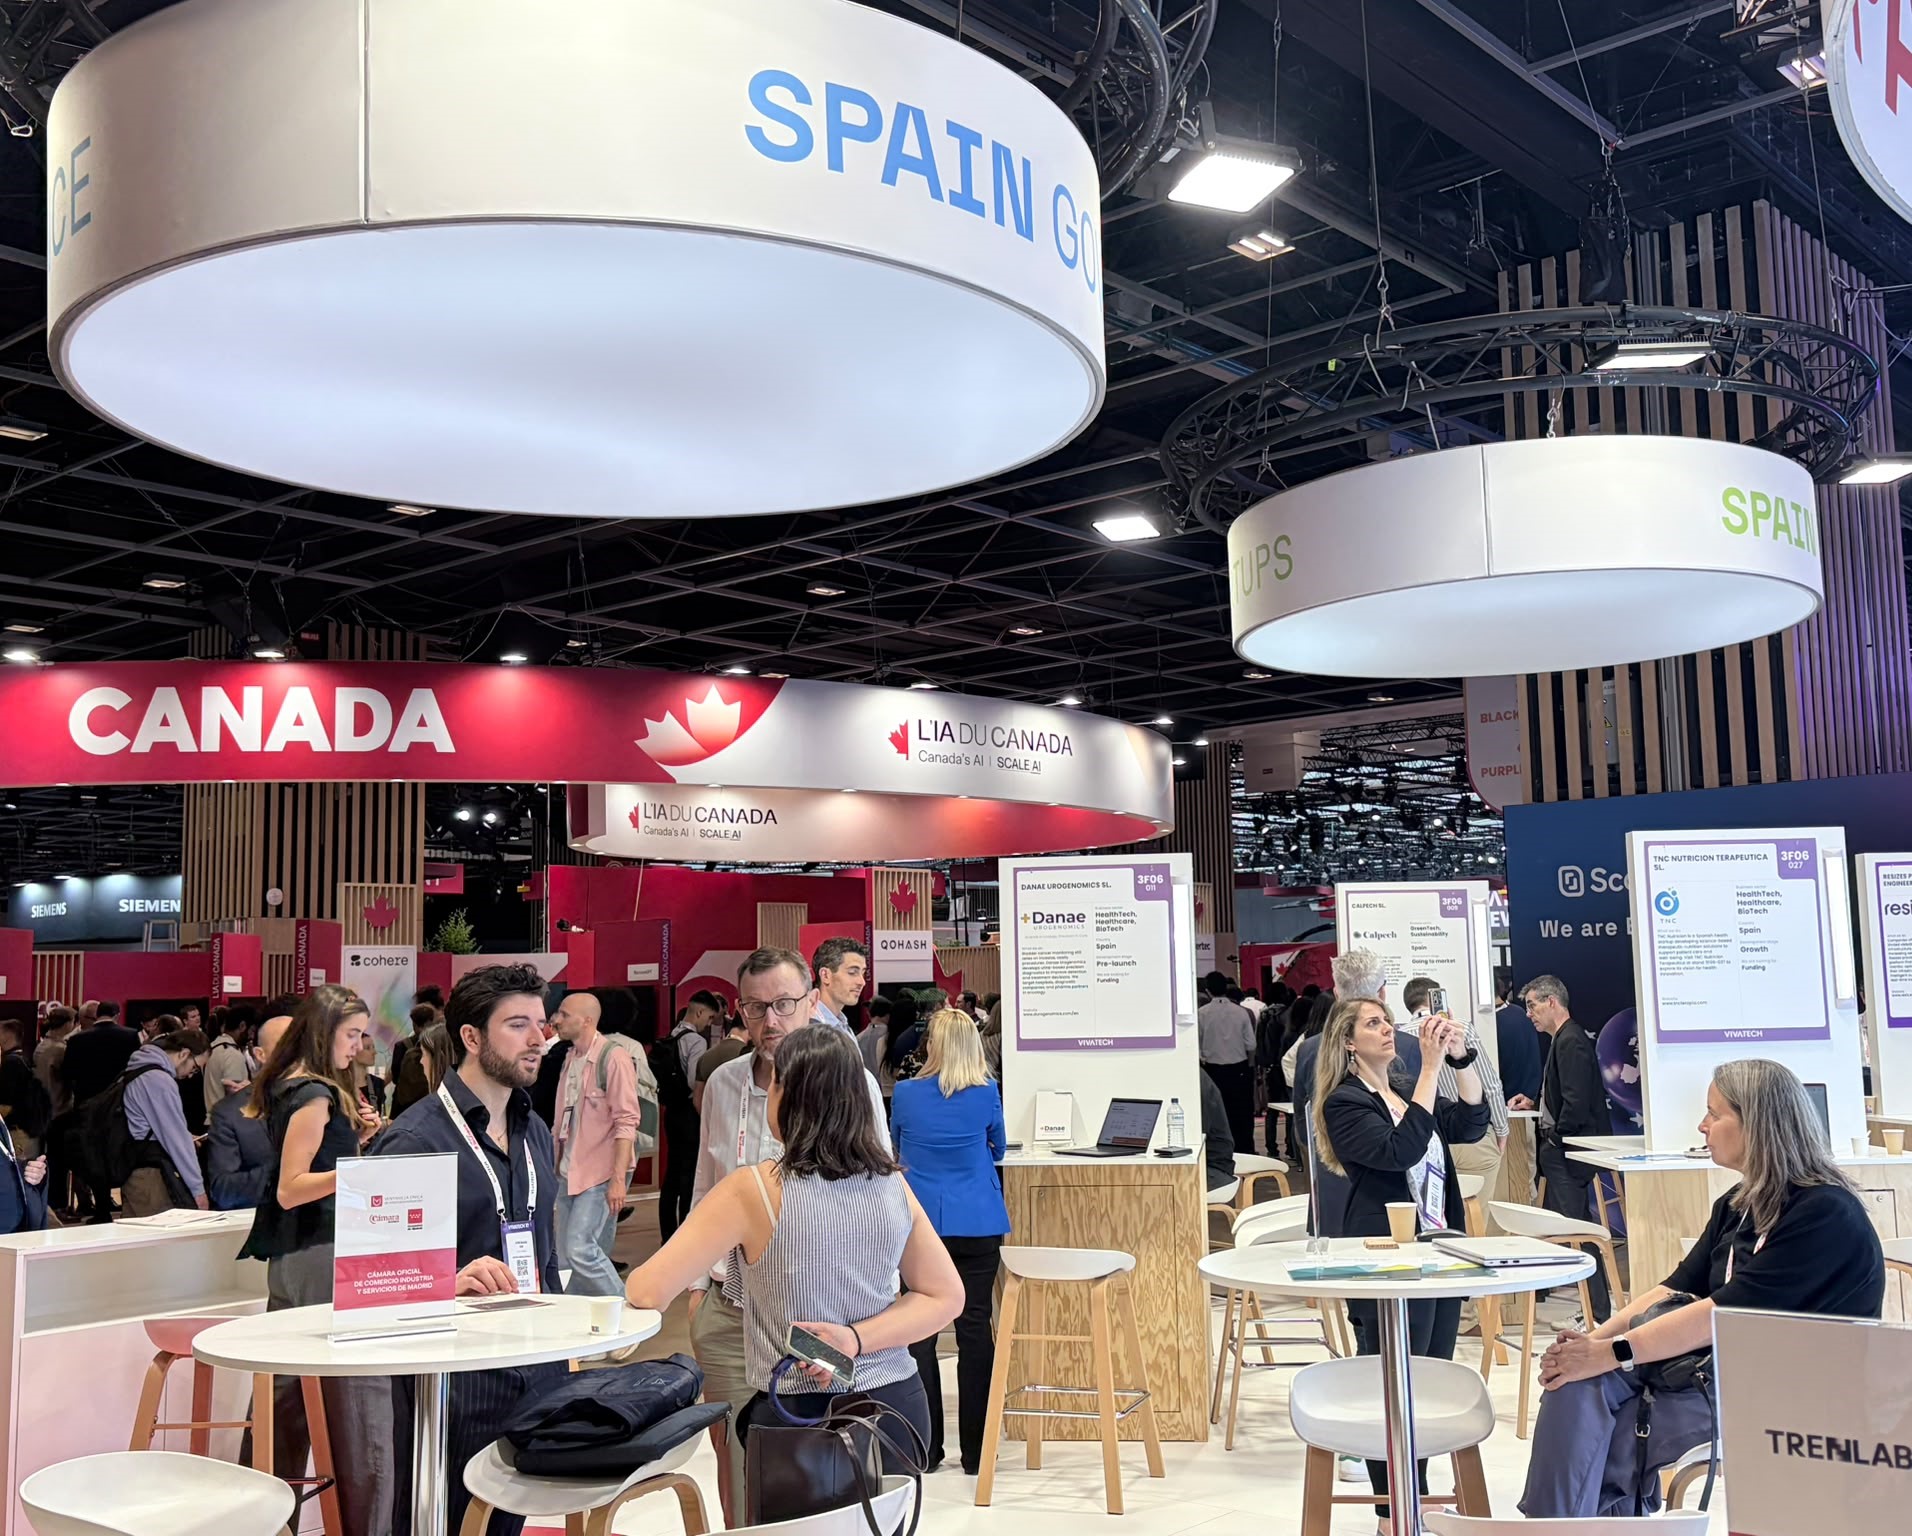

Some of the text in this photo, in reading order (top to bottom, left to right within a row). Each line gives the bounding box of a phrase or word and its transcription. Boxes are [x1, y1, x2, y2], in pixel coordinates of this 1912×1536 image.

[745, 70, 1097, 294] SPAIN GO
[1722, 487, 1816, 557] SPAIN
[69, 686, 456, 755] CANADA
[918, 719, 1073, 756] L'IA DU CANADA
[918, 750, 1041, 772] Canada's AI SCALE AI
[644, 802, 778, 824] L'IA DU CANADA
[644, 826, 741, 839] Canada's AI SCALE AI
[1781, 852, 1809, 861] 3F06
[1138, 875, 1164, 884] 3F06
[1047, 882, 1100, 890] UROGENOMICS
[32, 902, 67, 918] SIEMENS
[119, 899, 180, 912] SIEMEN
[1033, 912, 1086, 924] Danae
[1540, 920, 1572, 938] We
[1581, 922, 1617, 936] are
[1739, 926, 1761, 935] Spain
[1363, 931, 1397, 940] Calpech
[298, 925, 307, 966] CANADA
[881, 940, 927, 950] QOHASH
[1096, 942, 1116, 951] Spain
[363, 954, 408, 966] cohere
[298, 966, 305, 978] DU
[212, 974, 219, 984] DU
[367, 1270, 395, 1278] CÁMARA
[364, 1278, 399, 1286] COMERCIO
[363, 1286, 396, 1294] SERVICIOS
